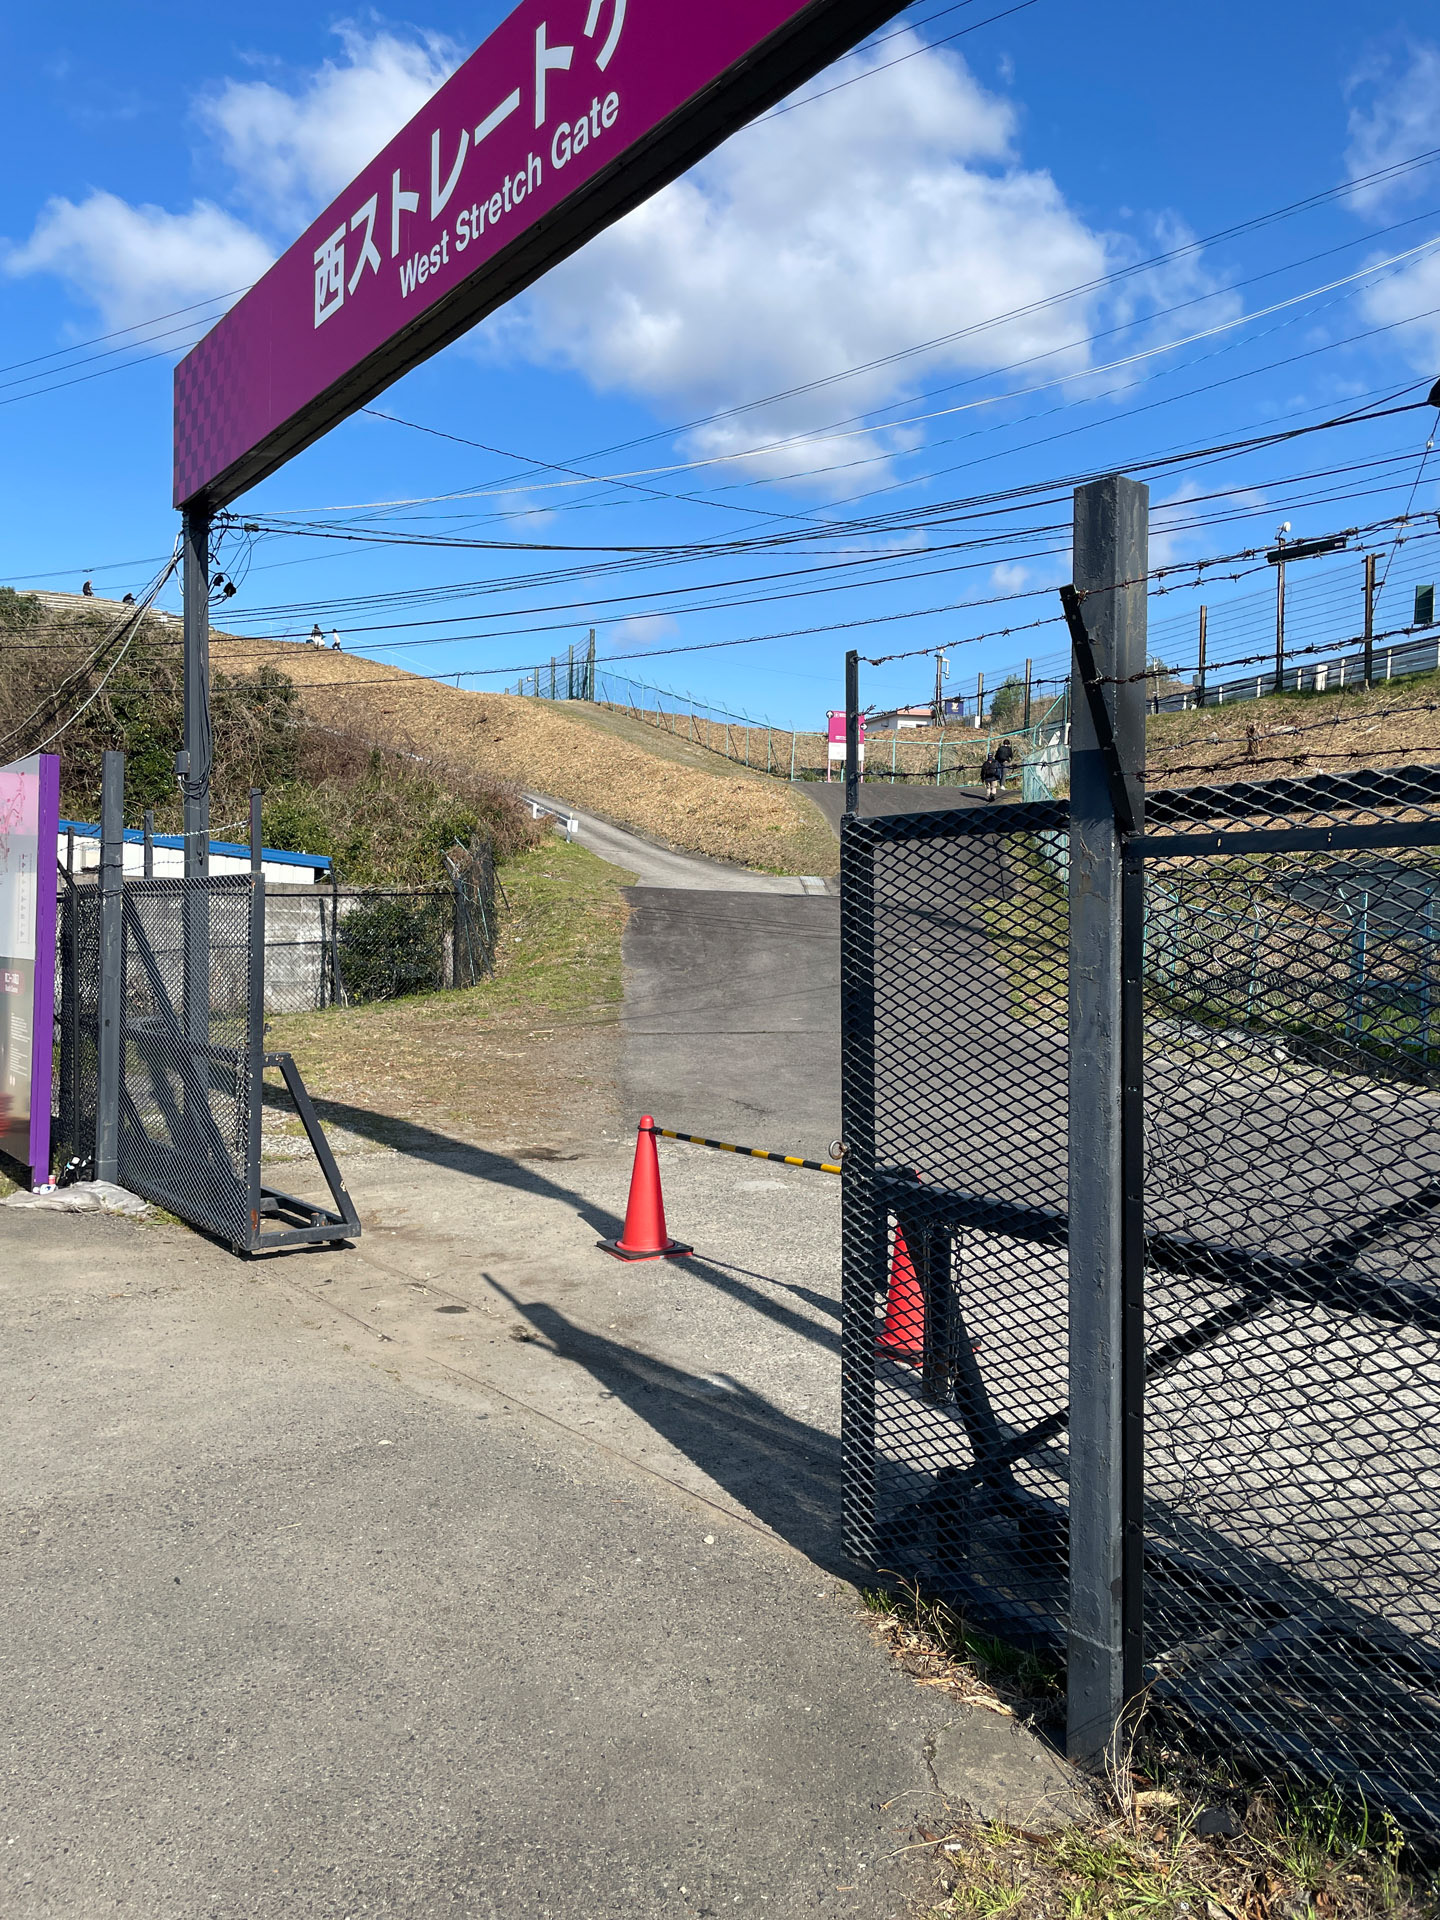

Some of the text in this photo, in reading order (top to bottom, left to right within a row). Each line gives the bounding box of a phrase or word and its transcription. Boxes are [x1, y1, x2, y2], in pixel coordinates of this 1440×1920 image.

[400, 88, 620, 299] West Stretch Gate
